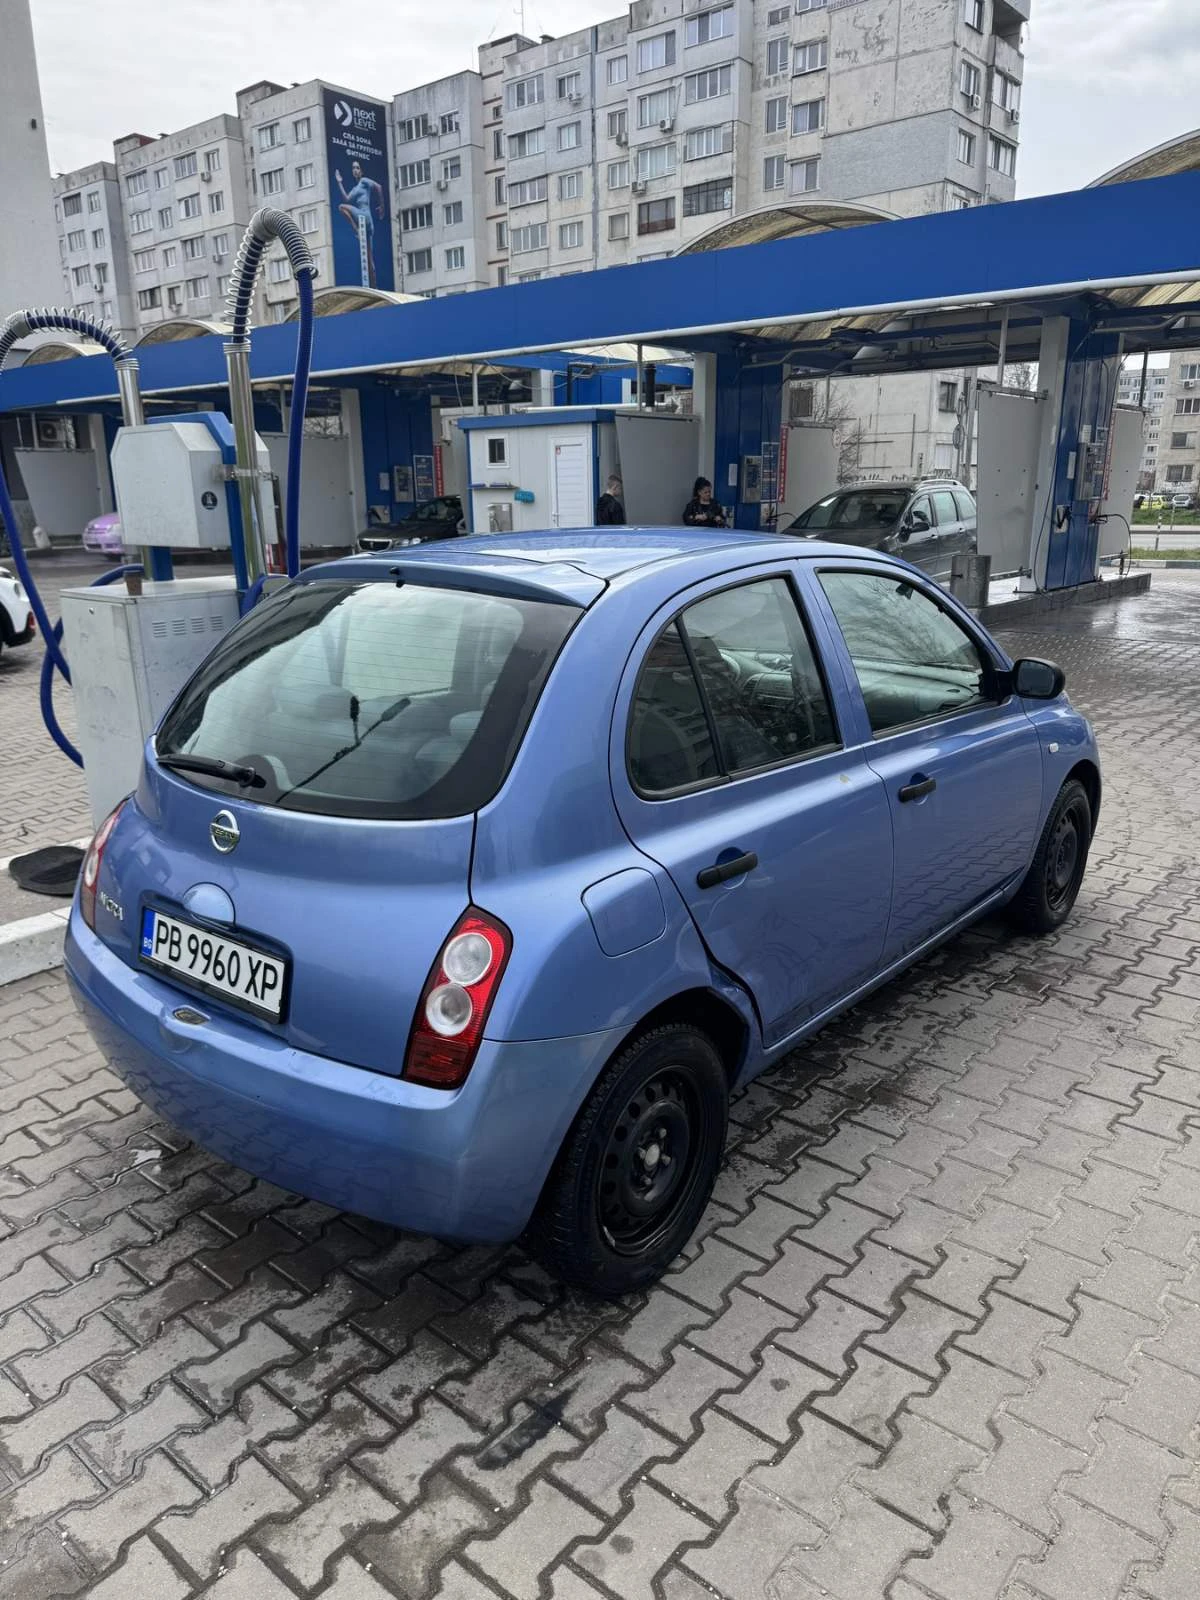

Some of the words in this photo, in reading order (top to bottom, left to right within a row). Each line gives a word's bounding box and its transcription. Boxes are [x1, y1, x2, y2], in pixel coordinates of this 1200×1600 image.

[353, 107, 376, 122] next
[353, 117, 377, 130] LEVEL
[155, 920, 182, 962] PB
[187, 933, 241, 987] 9960
[245, 956, 278, 1000] XP
